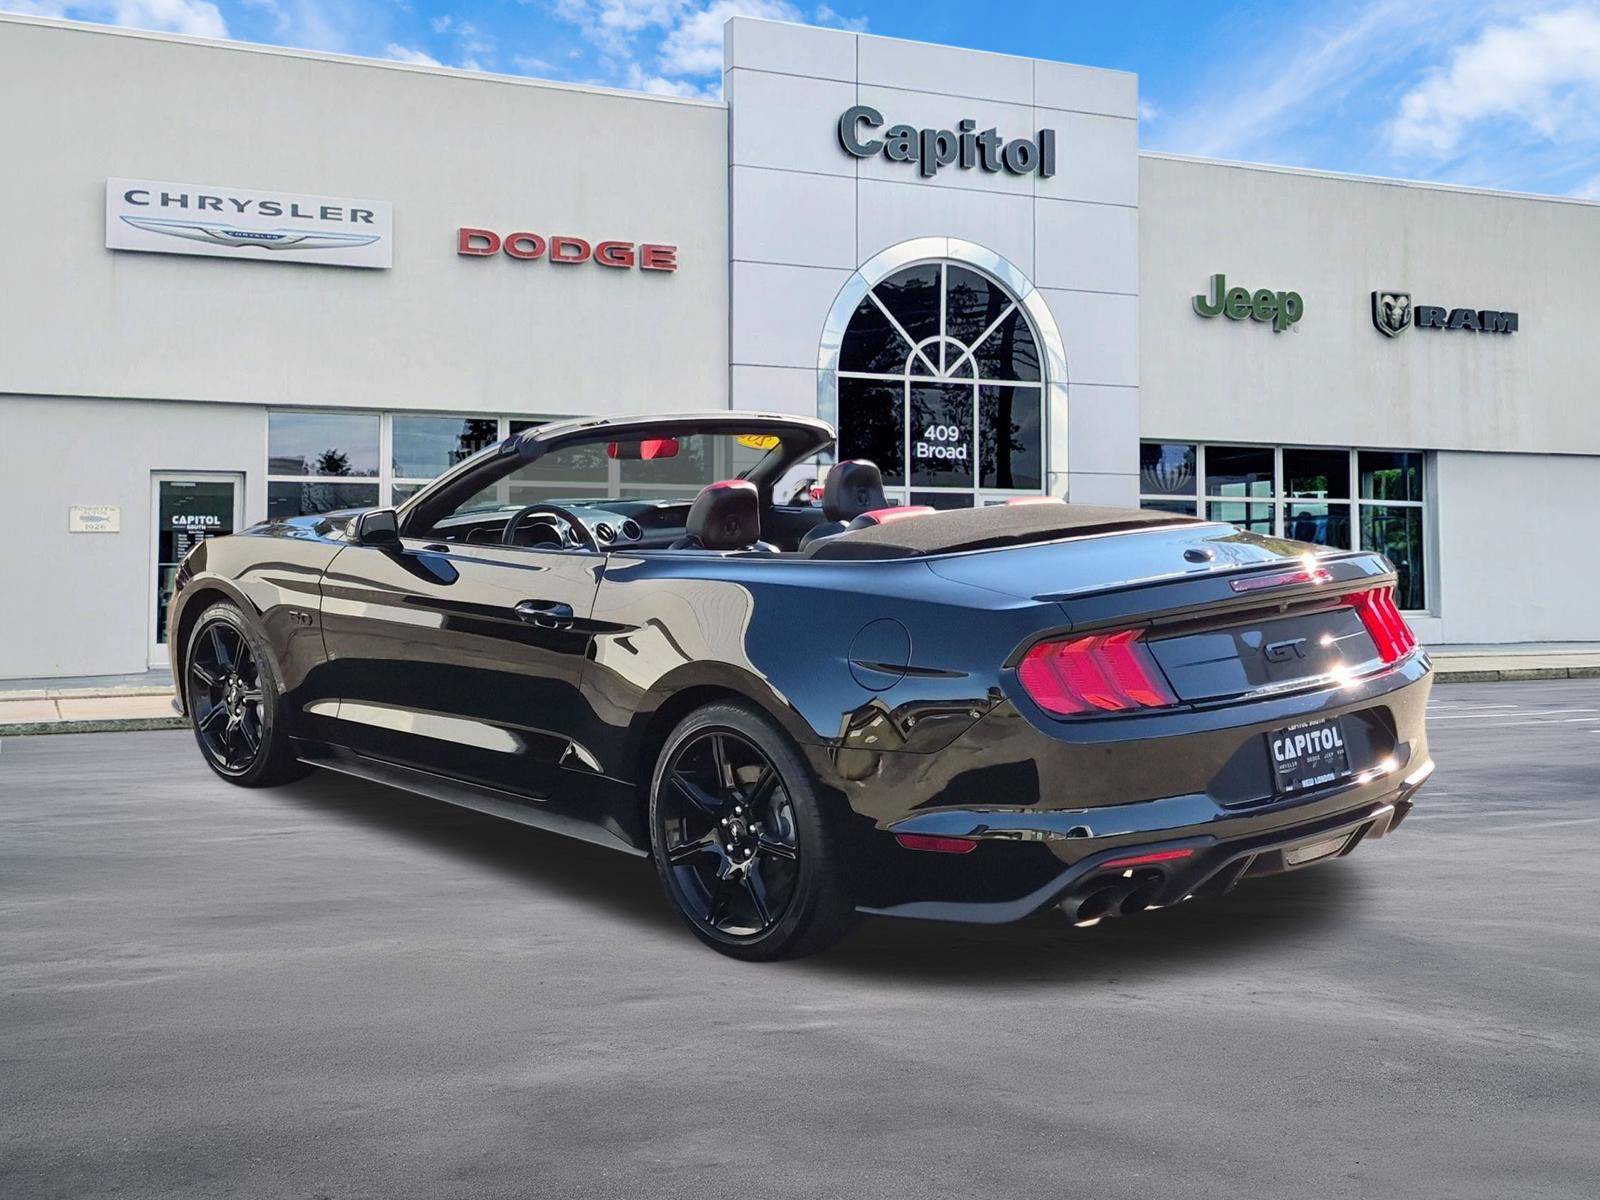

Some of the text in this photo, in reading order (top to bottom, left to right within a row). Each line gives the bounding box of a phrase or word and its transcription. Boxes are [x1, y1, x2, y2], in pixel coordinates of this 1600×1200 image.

[838, 105, 1056, 178] Capitol
[123, 189, 375, 224] CHRYSLER
[228, 231, 280, 240] CHRYSLER
[457, 227, 678, 273] DODGE
[1192, 273, 1304, 333] Jeep
[1414, 305, 1519, 333] RAM
[924, 424, 960, 442] 409
[916, 442, 967, 460] Broad
[172, 515, 221, 525] CAPITOL
[1264, 638, 1307, 663] GT
[1273, 726, 1343, 761] CAPITOL
